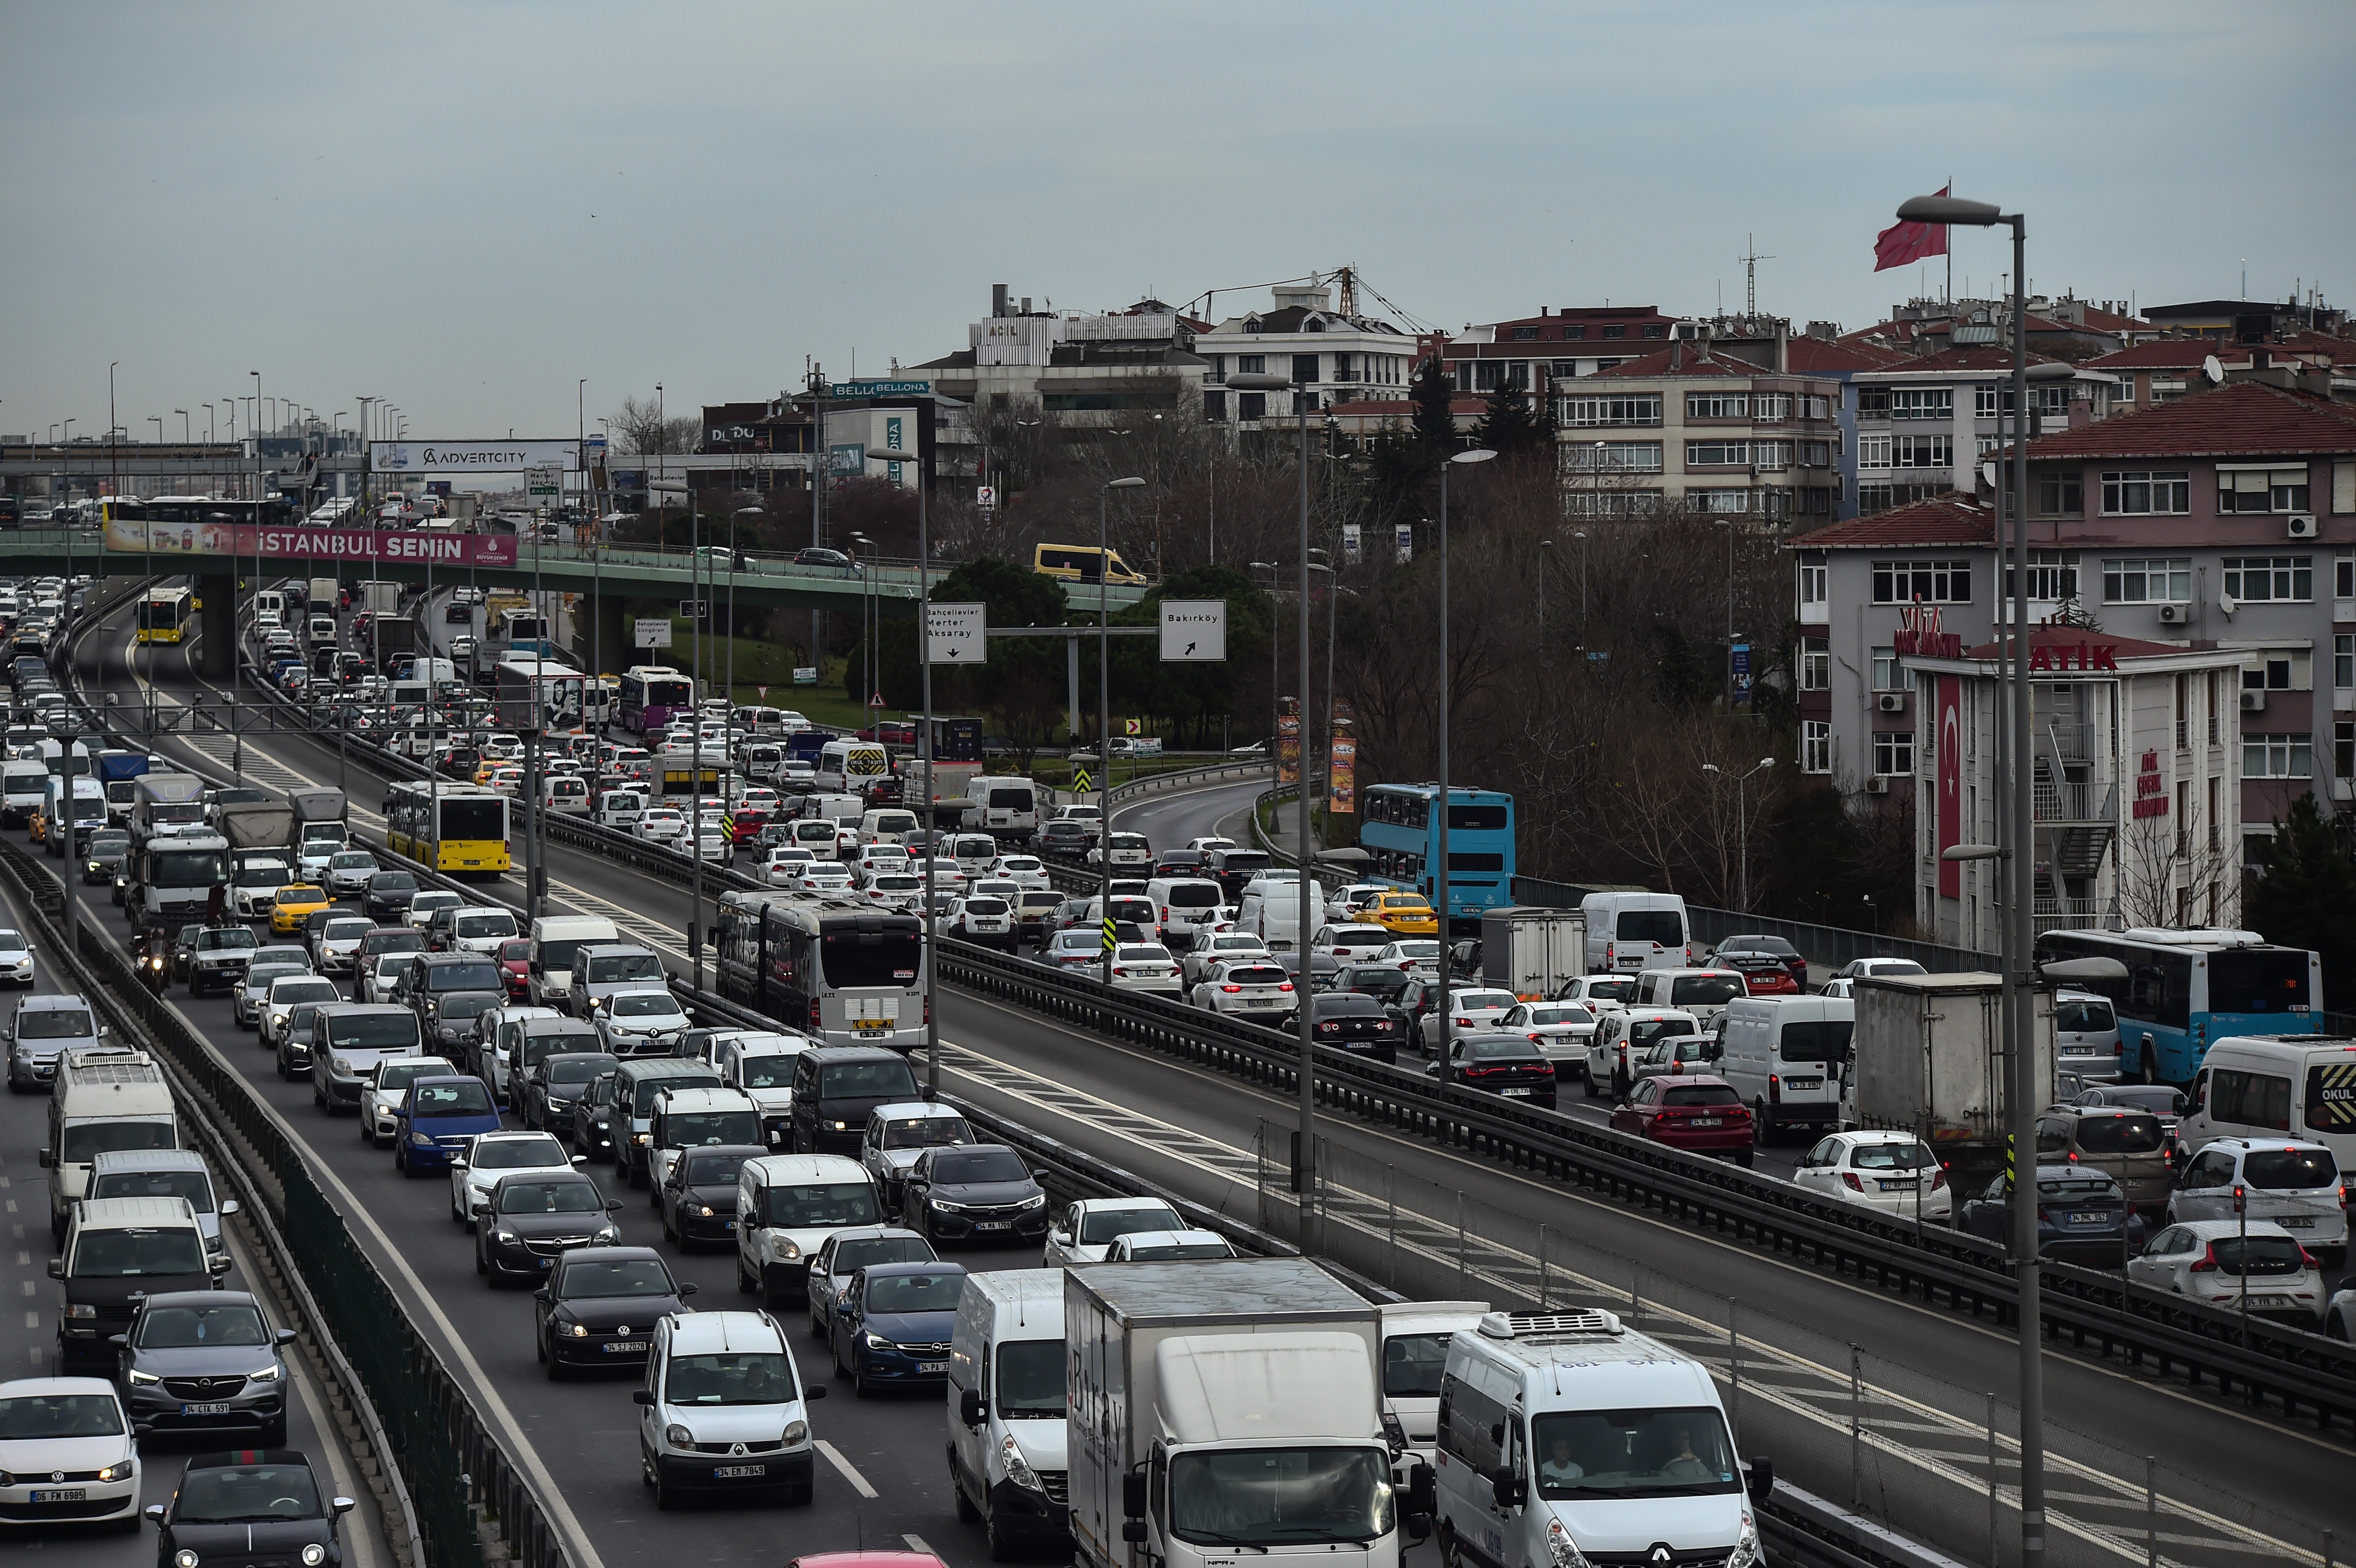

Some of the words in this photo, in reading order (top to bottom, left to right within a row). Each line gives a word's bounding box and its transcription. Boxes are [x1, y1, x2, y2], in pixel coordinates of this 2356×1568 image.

[876, 384, 926, 392] BELLONA
[440, 452, 527, 464] ADVERTCITY
[1168, 614, 1218, 624] Bakırköy
[927, 630, 972, 638] Aksaray
[2029, 640, 2119, 671] ATİK
[2322, 1089, 2354, 1101] OKUL
[629, 1342, 645, 1351] 2028
[186, 1405, 195, 1414] 34
[215, 1404, 228, 1412] 591
[719, 1468, 729, 1478] 34
[732, 1467, 741, 1476] EM
[744, 1465, 764, 1475] 7849
[38, 1493, 47, 1501] 06
[52, 1492, 64, 1500] FM
[65, 1491, 84, 1500] 6985
